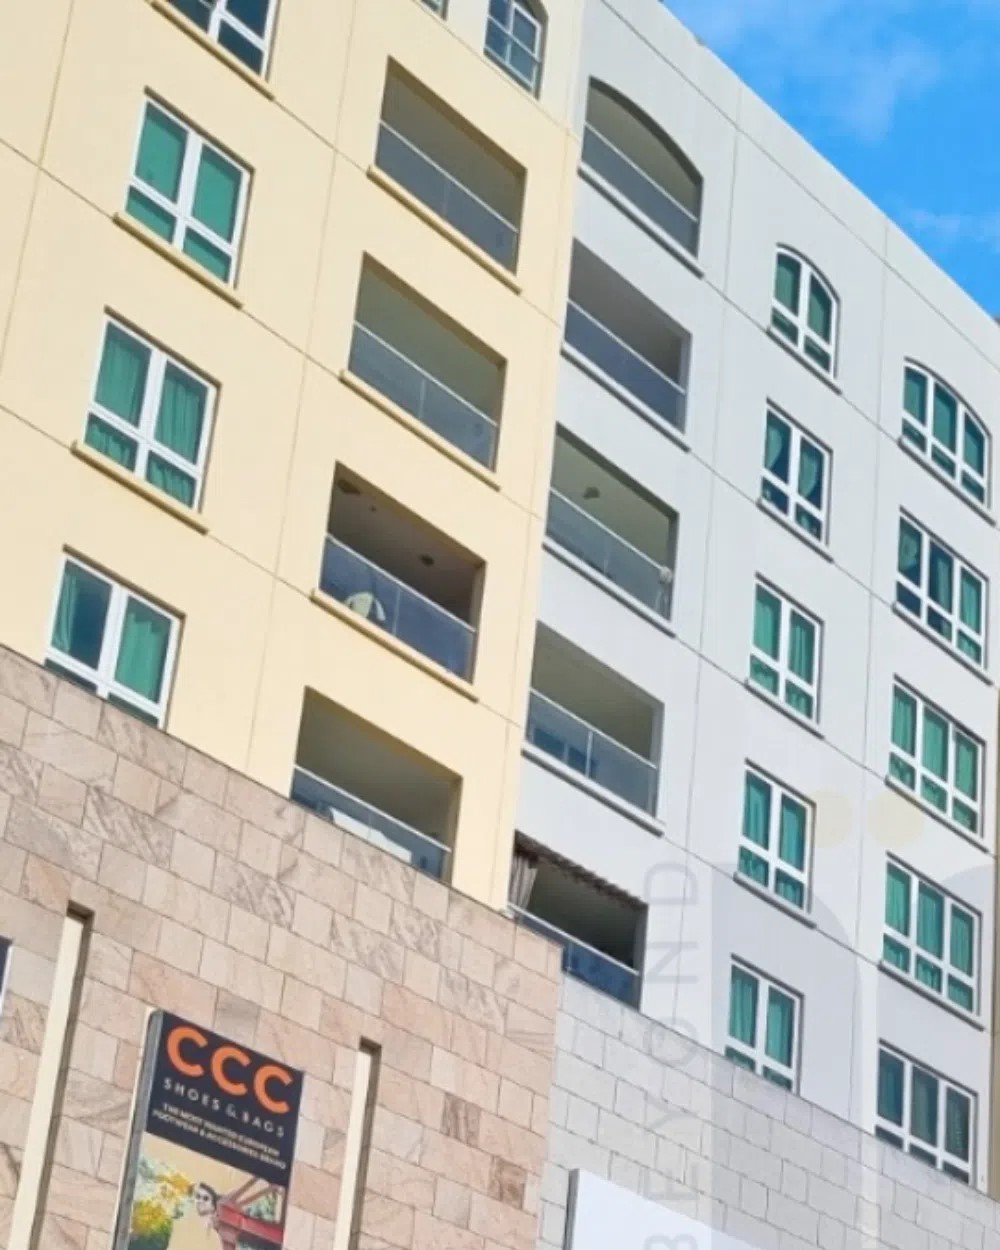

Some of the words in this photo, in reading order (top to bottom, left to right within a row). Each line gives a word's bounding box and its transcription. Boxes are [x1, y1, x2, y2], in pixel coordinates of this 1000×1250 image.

[167, 1025, 293, 1114] CCC
[163, 1077, 220, 1111] SHOES
[242, 1110, 285, 1138] BAGS
